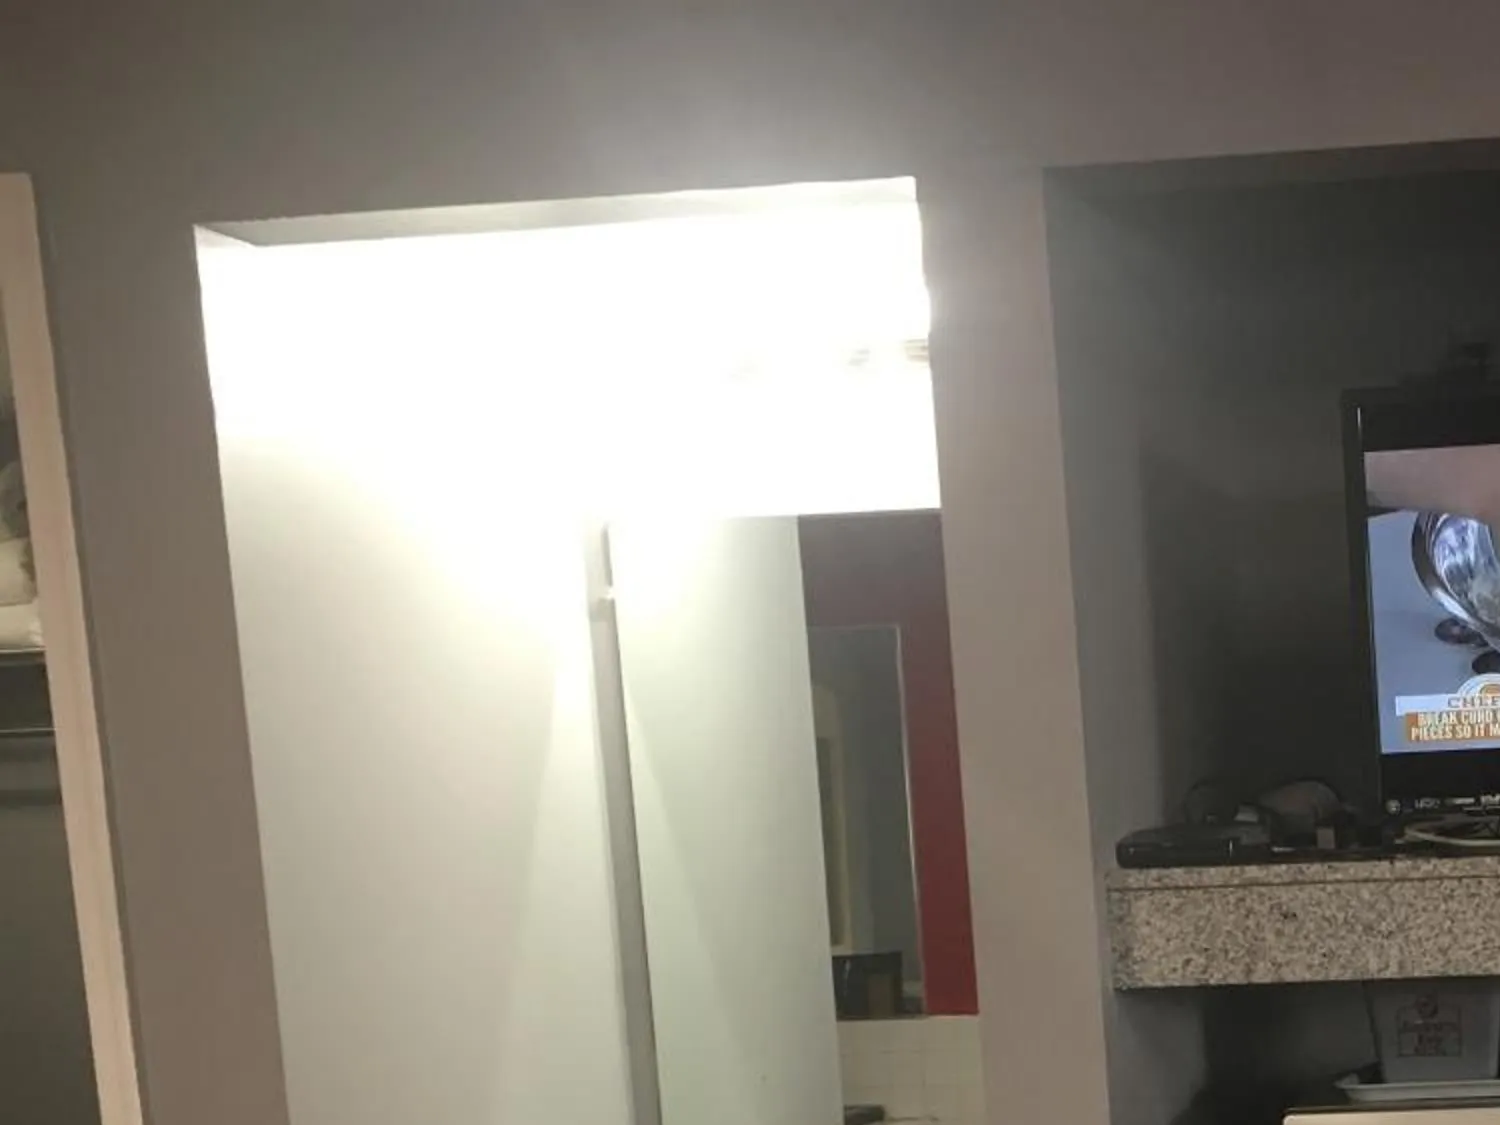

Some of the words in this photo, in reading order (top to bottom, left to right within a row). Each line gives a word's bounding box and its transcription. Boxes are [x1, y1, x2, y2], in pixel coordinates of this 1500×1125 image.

[1448, 695, 1500, 708] CHEF
[1417, 711, 1458, 726] BREAK
[1411, 727, 1452, 741] PIECES
[1455, 726, 1471, 739] SO
[1474, 724, 1485, 738] IT
